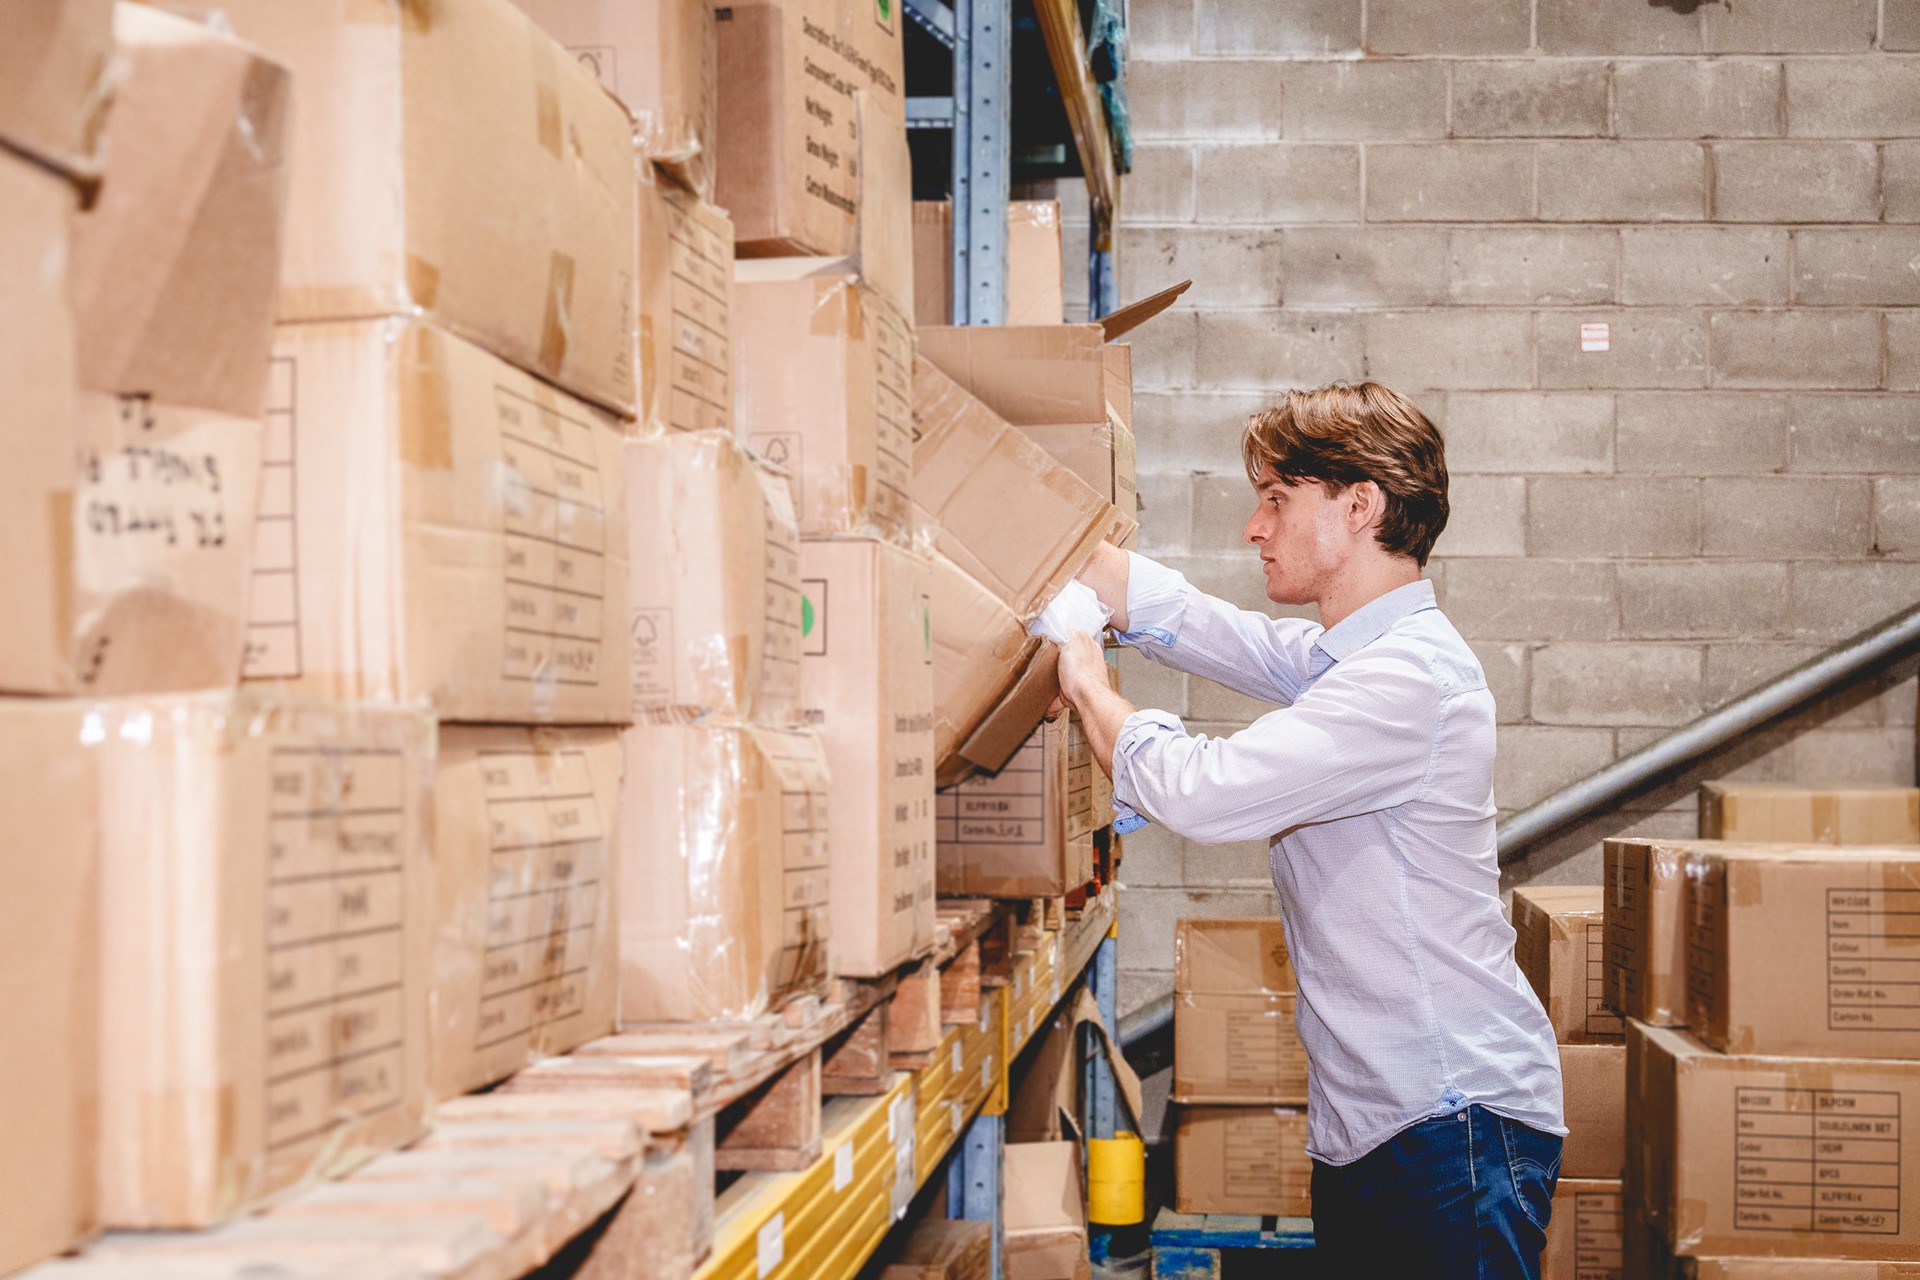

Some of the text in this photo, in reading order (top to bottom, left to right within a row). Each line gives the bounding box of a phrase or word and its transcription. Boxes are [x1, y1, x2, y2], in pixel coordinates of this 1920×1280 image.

[1832, 942, 1859, 953] Colour
[1832, 965, 1867, 977] Quantity
[1832, 988, 1855, 999] Order
[1833, 1012, 1860, 1022] Carton
[1740, 1165, 1767, 1177] Quantity
